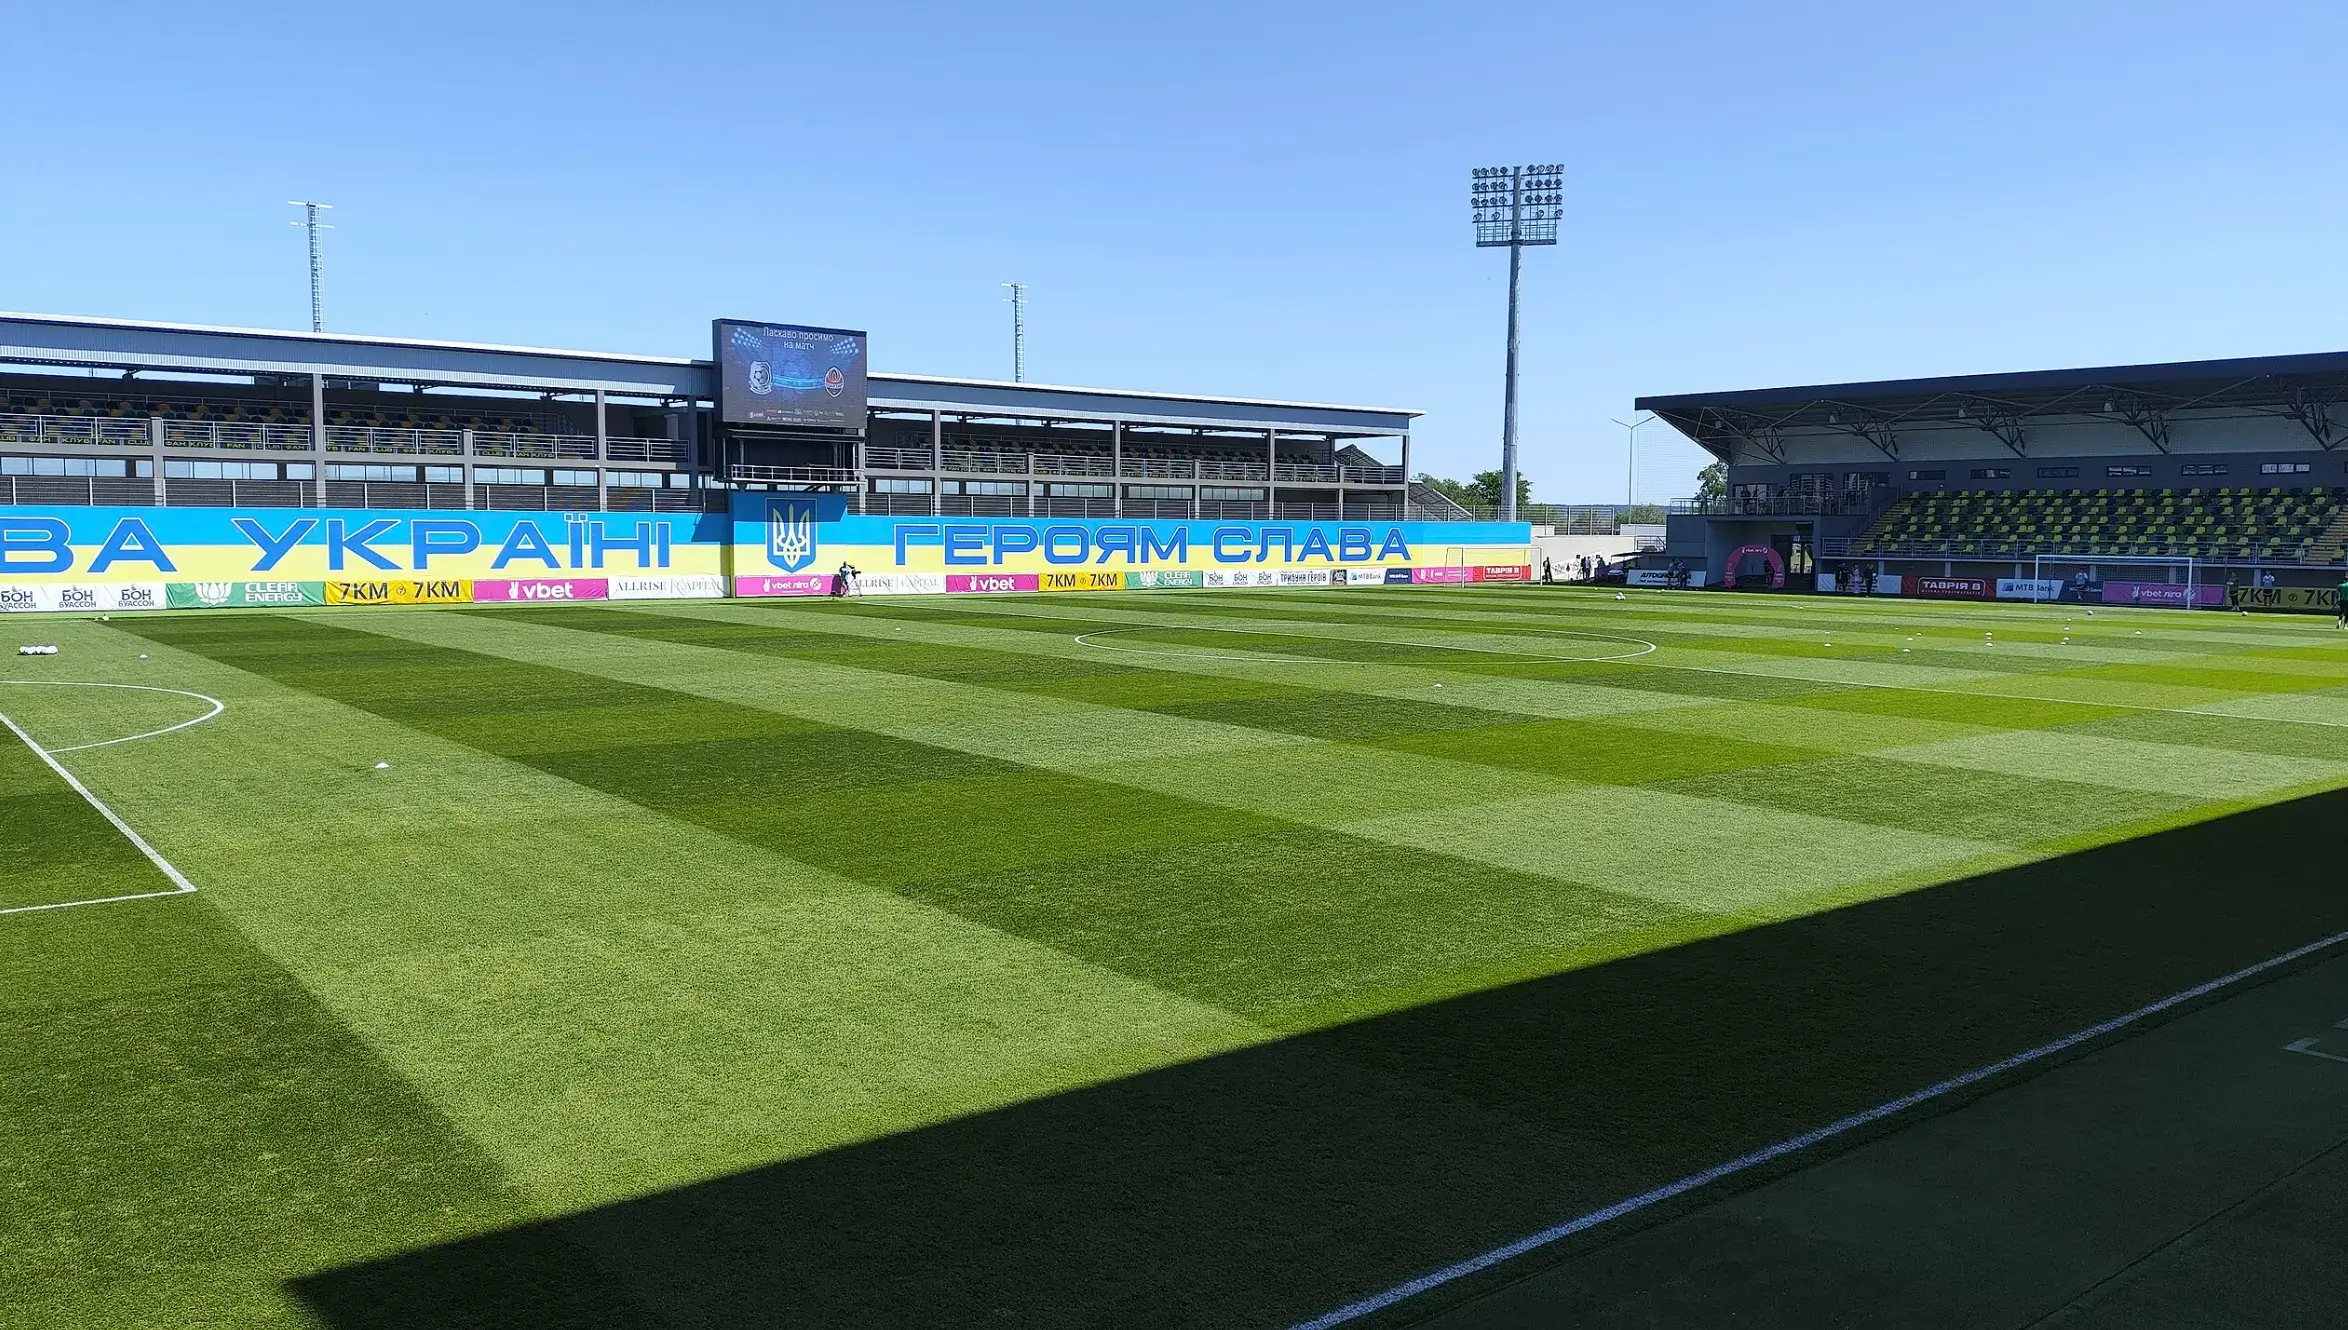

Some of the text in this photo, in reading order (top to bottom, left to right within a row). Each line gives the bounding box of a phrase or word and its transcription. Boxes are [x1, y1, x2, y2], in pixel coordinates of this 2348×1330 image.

[763, 326, 834, 343] Ласкаво просимо
[795, 342, 815, 351] матч
[230, 513, 671, 573] УКРАЇНІ
[893, 523, 1412, 566] ГЕРОЯМ СЛАВА
[616, 581, 668, 592] ALLRISE
[772, 580, 792, 589] vbet
[979, 575, 1015, 591] vbet
[1922, 581, 1981, 591] ТАВРІЯ В
[62, 589, 94, 602] БОН
[121, 589, 152, 601] БОН
[523, 581, 574, 599] vbet
[2140, 590, 2162, 598] vbet
[0, 590, 34, 603] БОН
[245, 592, 303, 602] ENERGY
[59, 601, 97, 609] БУАССОН
[118, 600, 155, 608] БУАССОН
